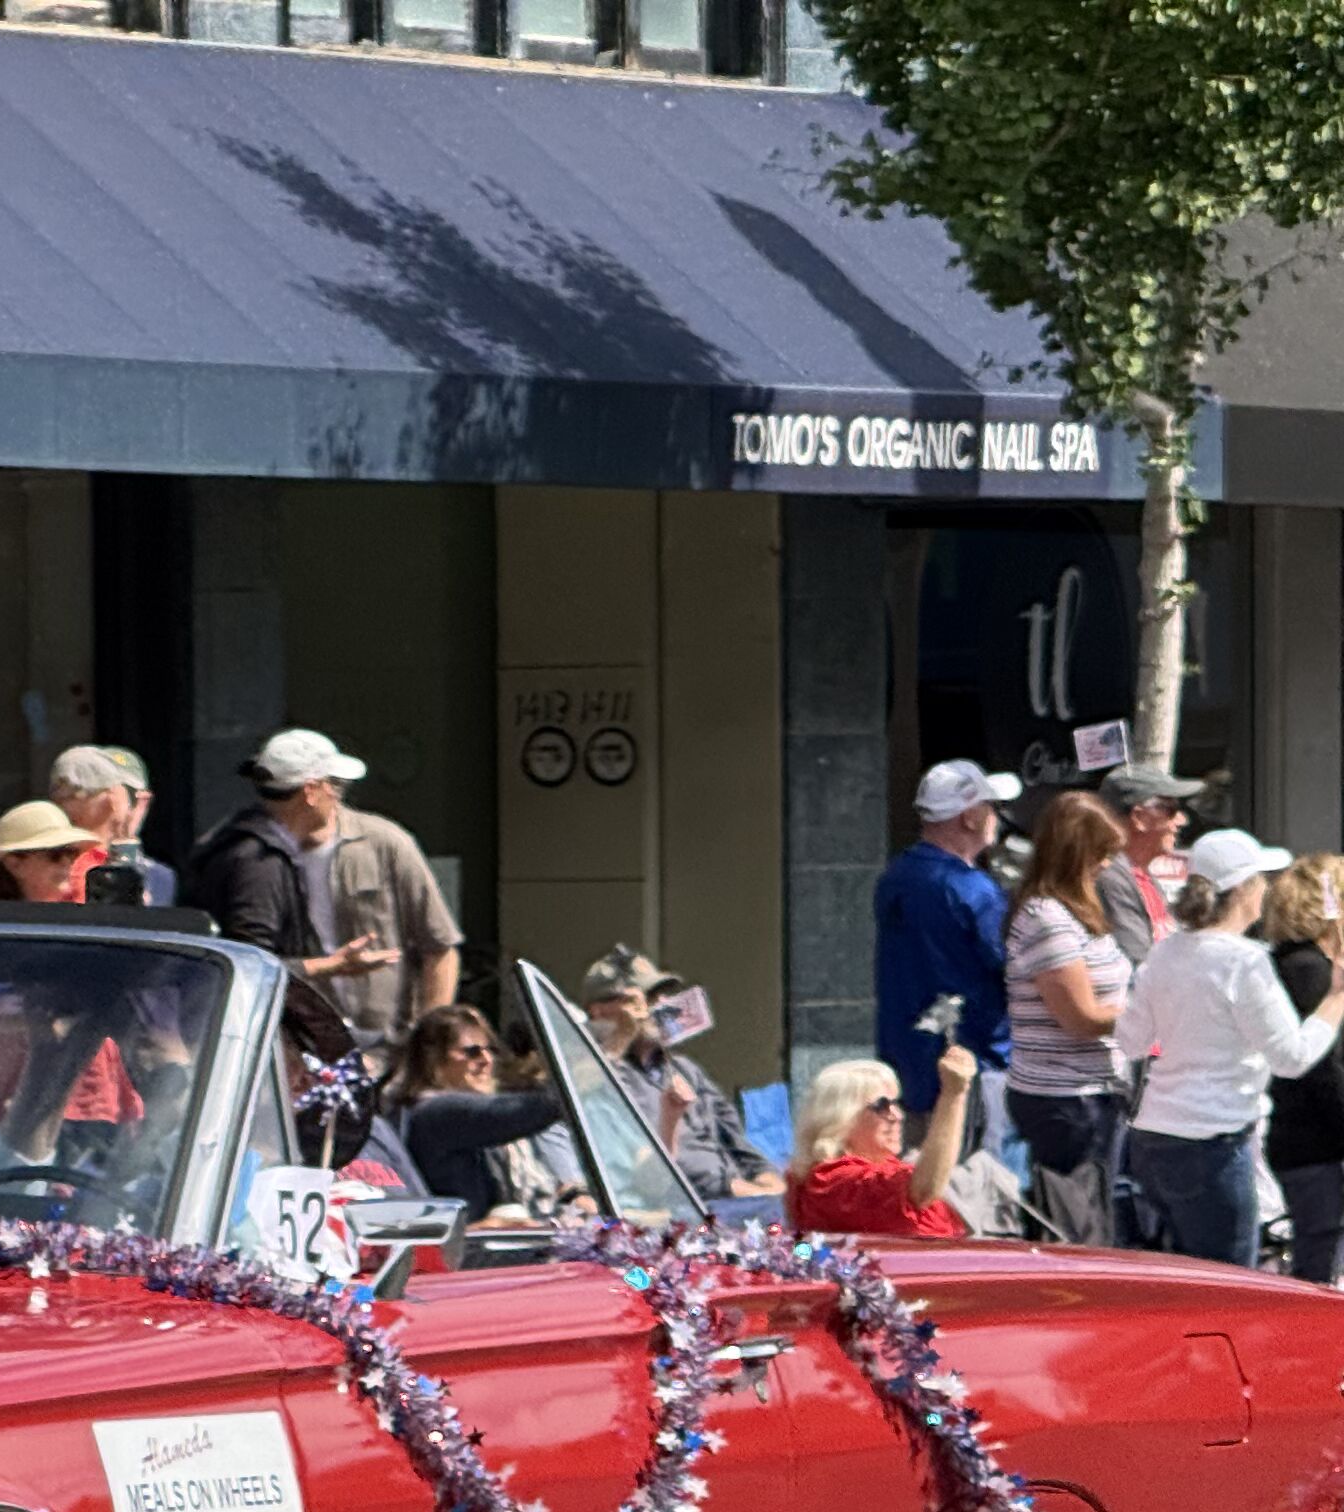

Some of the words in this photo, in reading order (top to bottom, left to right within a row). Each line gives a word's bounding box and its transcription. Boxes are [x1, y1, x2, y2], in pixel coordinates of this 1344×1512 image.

[732, 412, 841, 467] TOMO'S
[846, 415, 976, 471] ORGANIC
[981, 420, 1044, 472] NAIL
[1048, 421, 1101, 472] SPA
[277, 1189, 326, 1264] 52
[187, 1478, 216, 1511] ON
[215, 1474, 283, 1510] WHEELS
